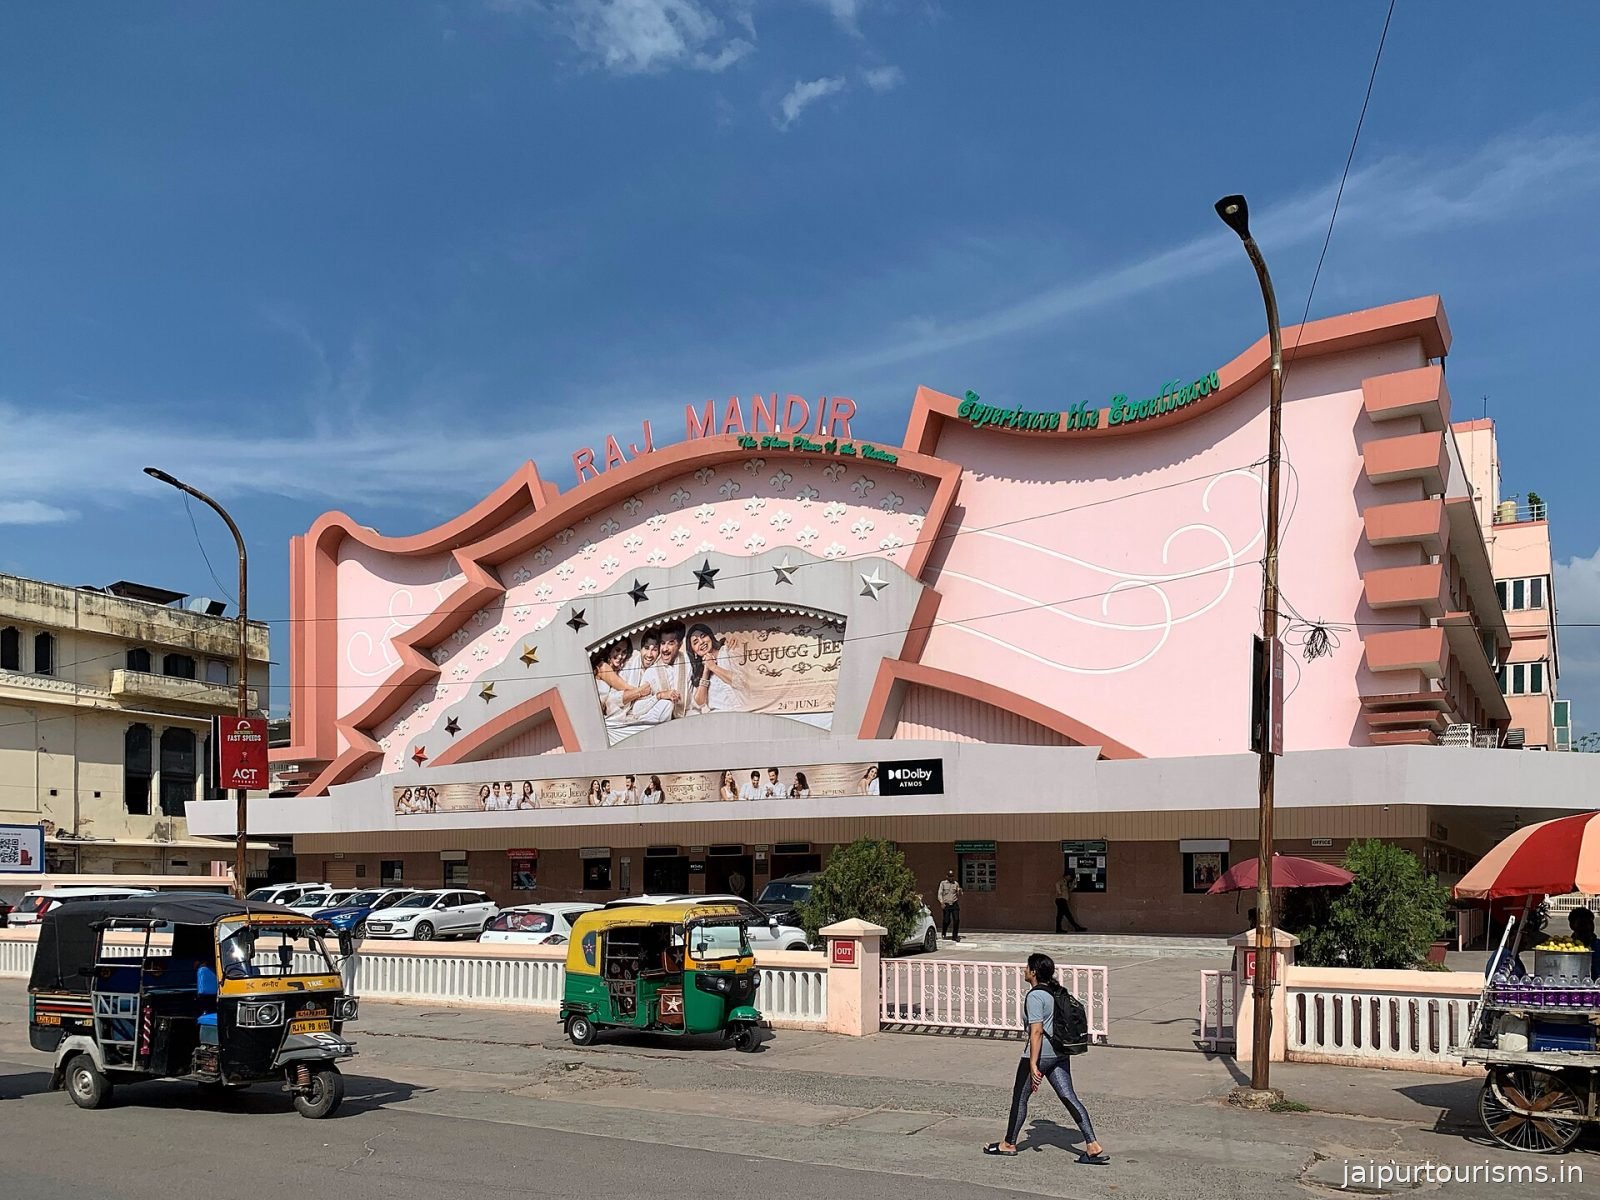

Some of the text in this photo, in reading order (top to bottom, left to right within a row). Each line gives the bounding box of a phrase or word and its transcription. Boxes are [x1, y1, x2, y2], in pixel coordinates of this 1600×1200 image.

[957, 369, 1221, 430] Experience the Excellence
[571, 392, 857, 483] RAJ MANDIR
[737, 435, 898, 464] The Show Place of the Nation
[739, 633, 844, 666] JUGJUGG JEE
[794, 699, 820, 710] JUNE
[227, 734, 262, 742] FAST SPEEDS
[232, 768, 258, 780] ACT
[902, 768, 932, 781] Dolby
[836, 947, 852, 956] OUT
[292, 1023, 306, 1032] RJ14
